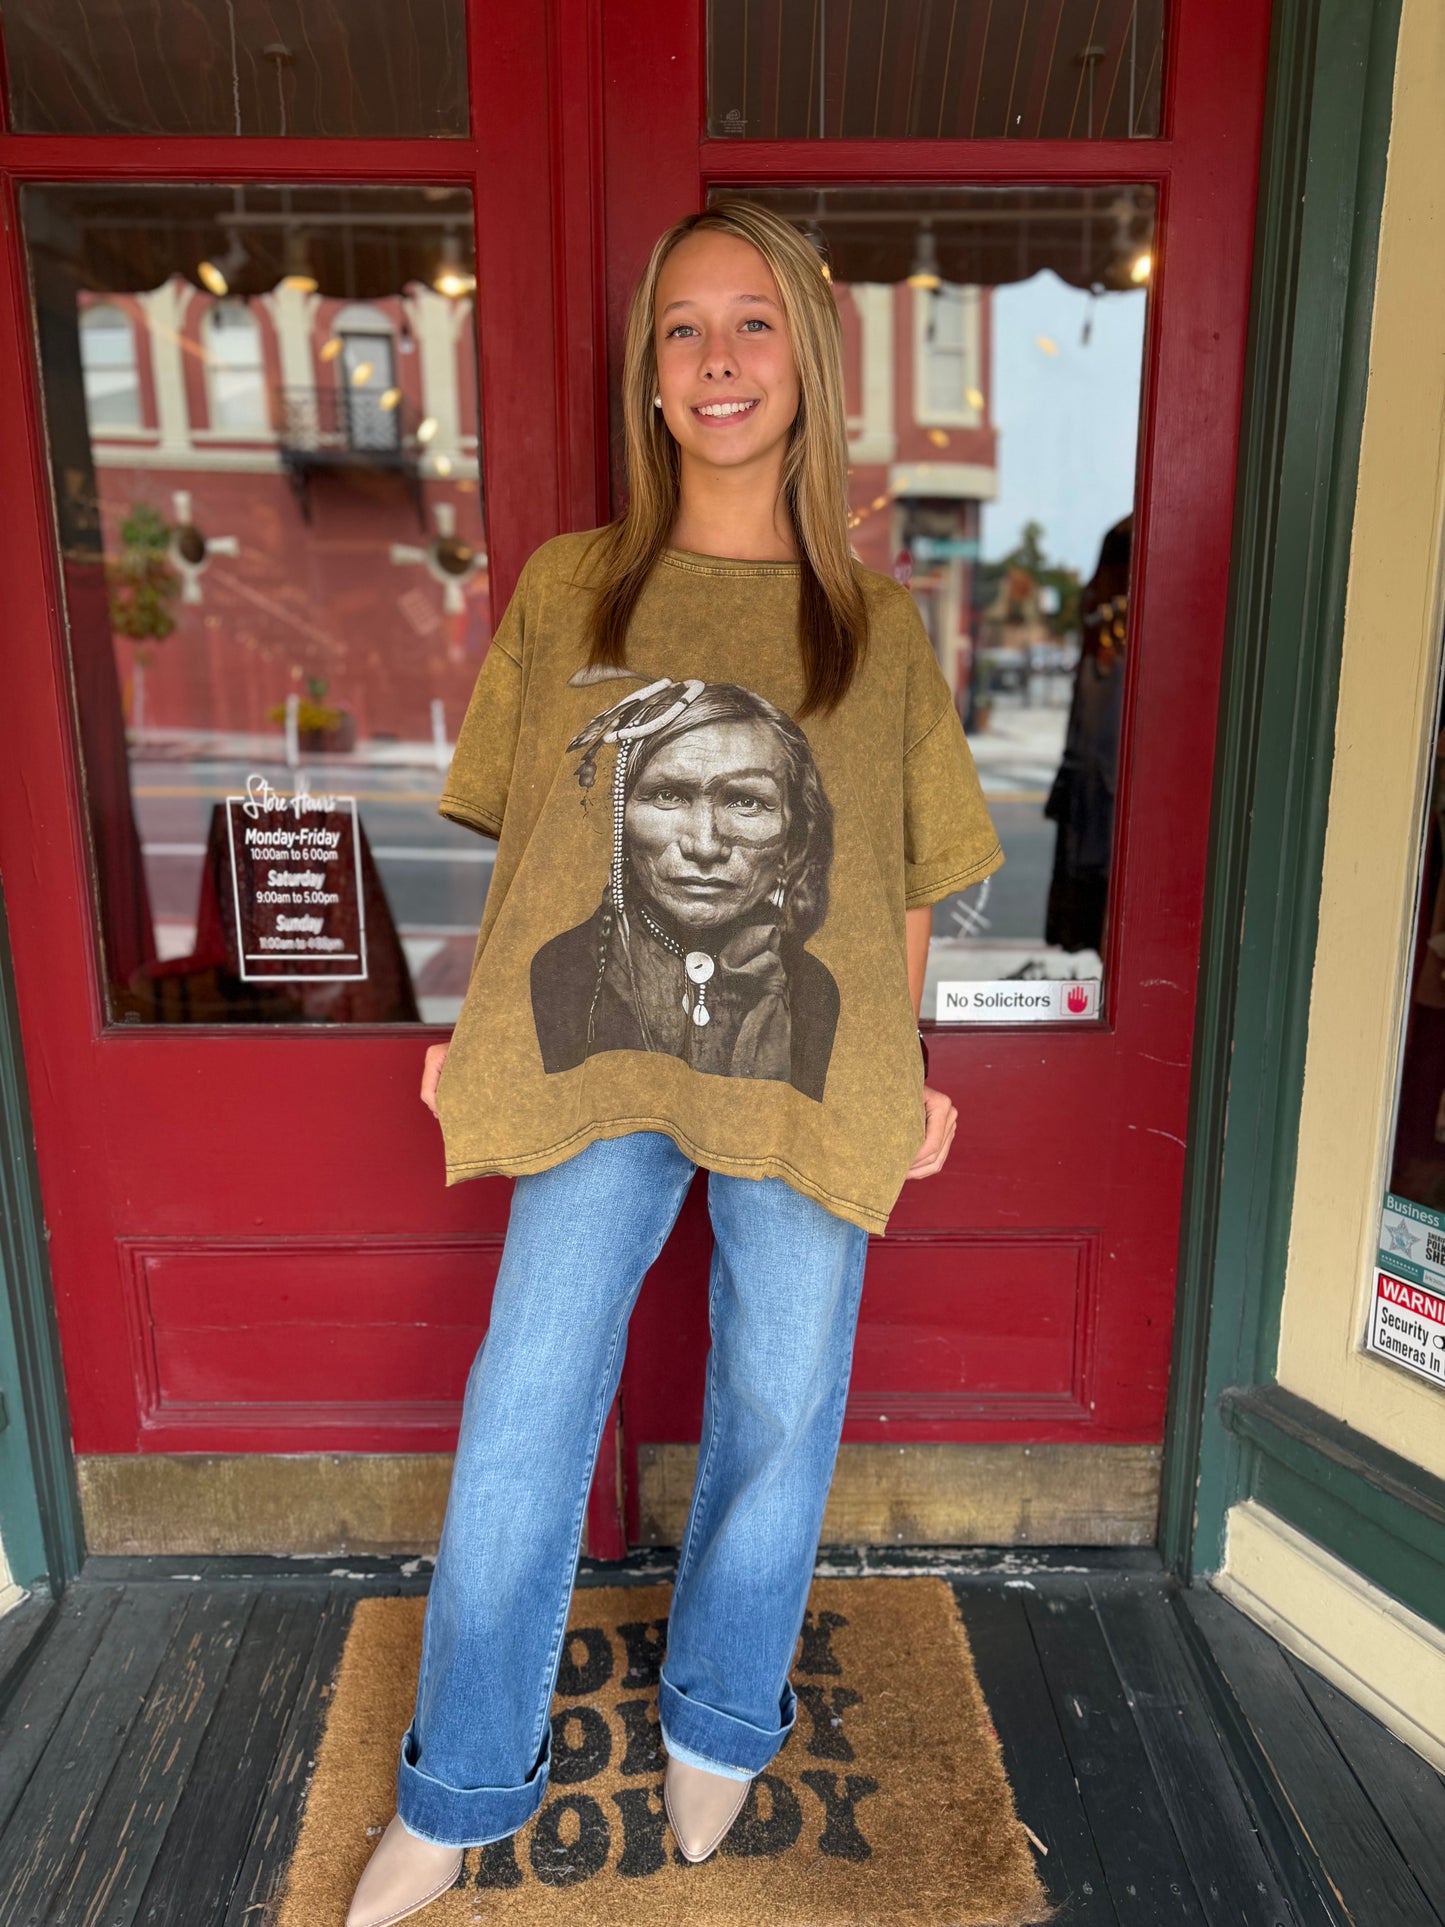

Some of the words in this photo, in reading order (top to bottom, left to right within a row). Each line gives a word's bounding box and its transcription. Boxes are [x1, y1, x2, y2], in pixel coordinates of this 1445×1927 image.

[243, 775, 288, 819] Store
[245, 828, 340, 848] Monday-Friday
[251, 848, 289, 861] 10:00am
[290, 848, 301, 860] to
[302, 848, 339, 862] 600pm
[267, 869, 326, 890] Saturday
[256, 891, 291, 903] 9:00am
[292, 891, 302, 903] to
[276, 914, 324, 935] Sunday
[946, 993, 968, 1008] No
[973, 992, 1051, 1008] Solicitors
[1387, 1195, 1440, 1227] Business
[1383, 1278, 1445, 1324] WARNI
[1381, 1306, 1429, 1346] Security
[1379, 1328, 1426, 1365] Cameras
[1430, 1352, 1440, 1373] In
